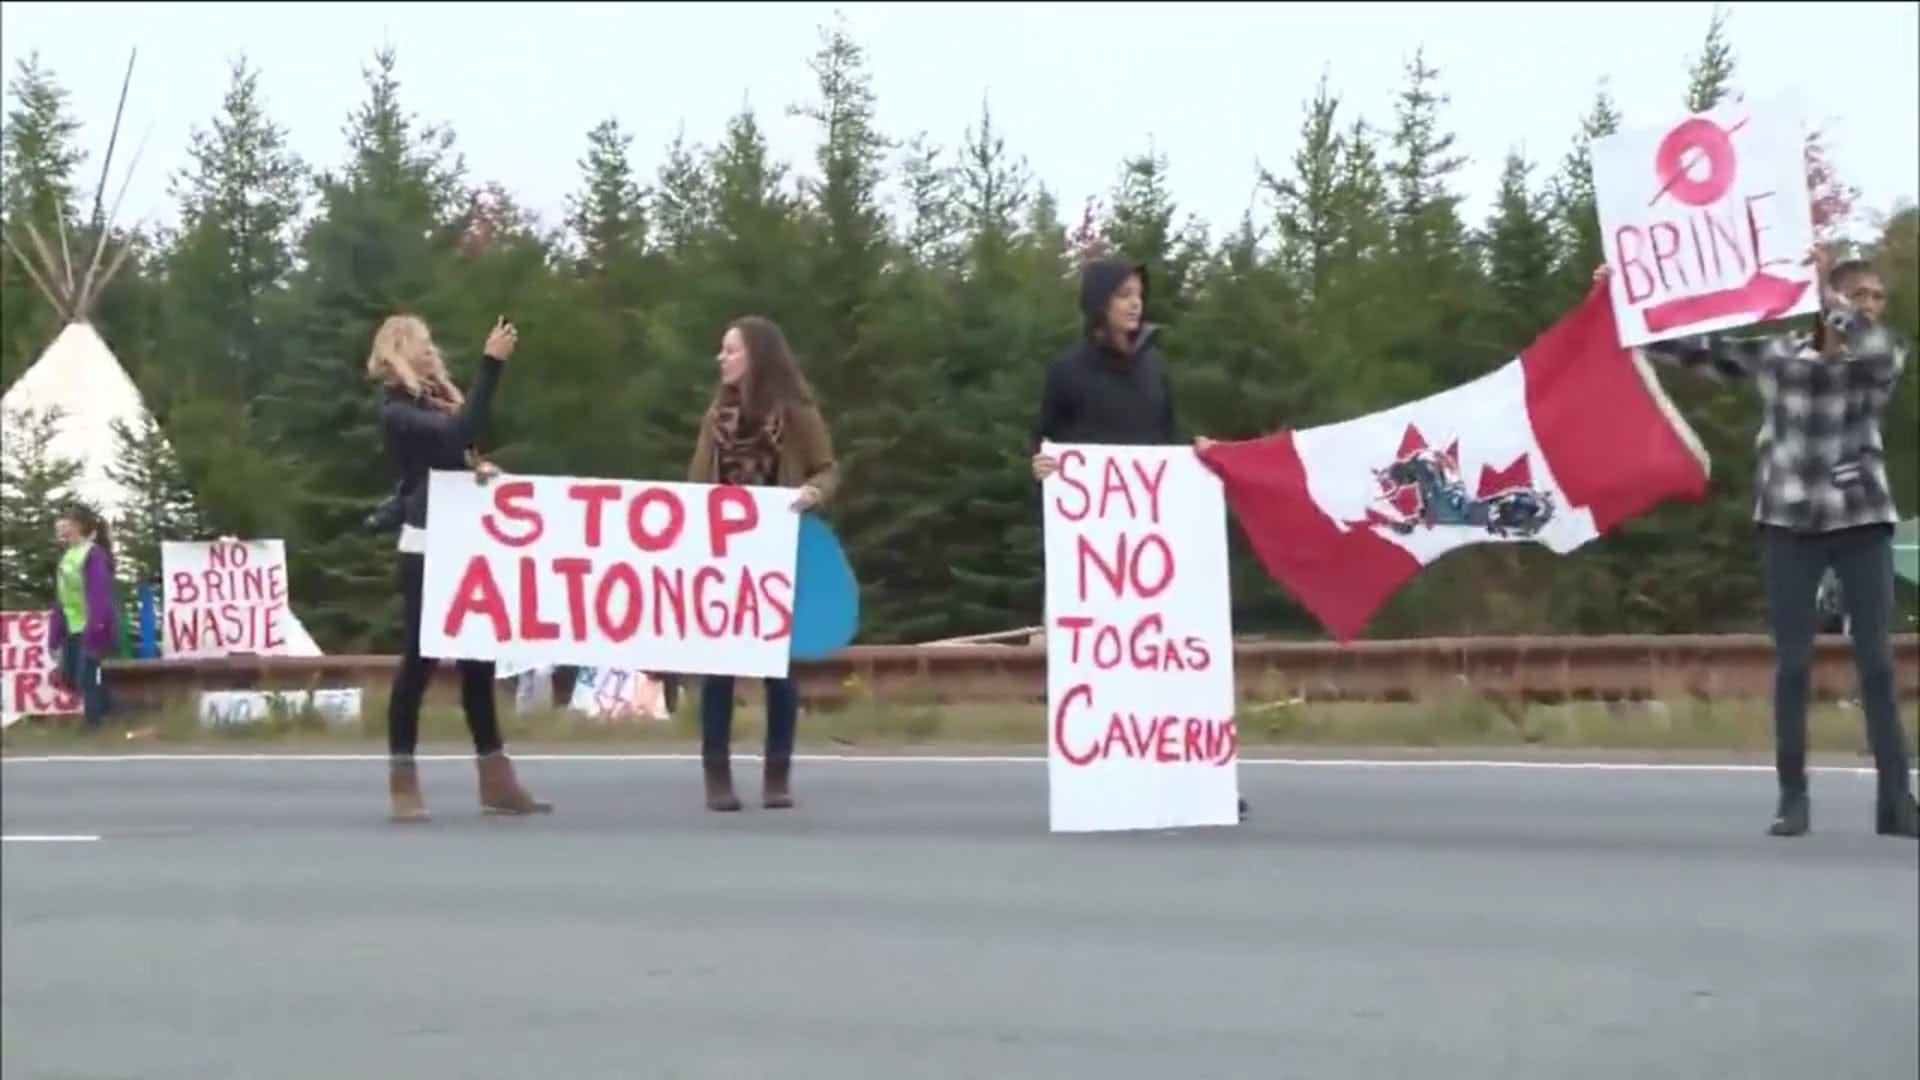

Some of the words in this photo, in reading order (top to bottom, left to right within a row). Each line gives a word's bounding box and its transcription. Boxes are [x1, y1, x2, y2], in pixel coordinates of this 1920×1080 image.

[1615, 191, 1793, 305] BRINE
[481, 481, 758, 558] STOP
[1056, 449, 1167, 523] SAY
[172, 564, 286, 604] BRINE
[209, 543, 249, 568] NO
[1077, 532, 1174, 601] NO
[442, 555, 792, 642] ALTONGAS
[1054, 683, 1236, 767] CAVERNS
